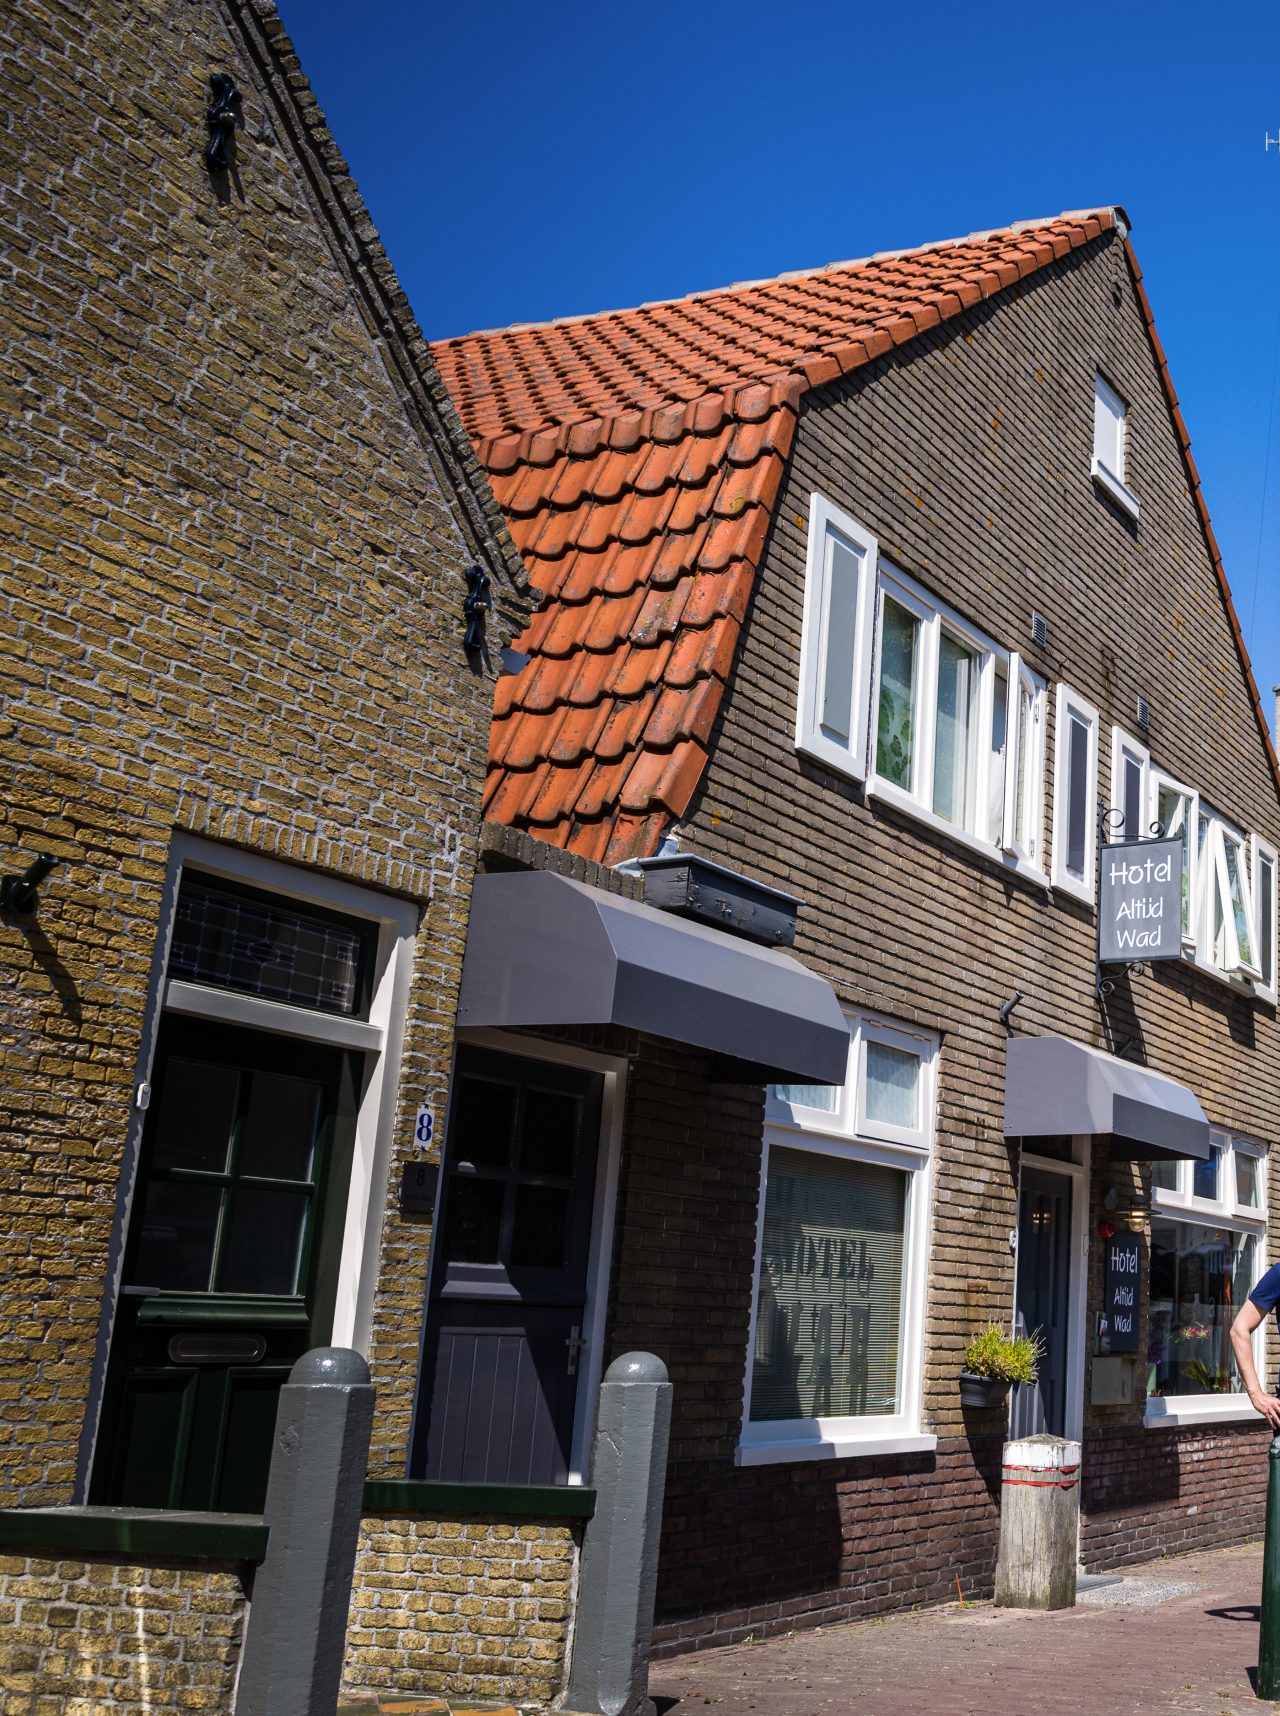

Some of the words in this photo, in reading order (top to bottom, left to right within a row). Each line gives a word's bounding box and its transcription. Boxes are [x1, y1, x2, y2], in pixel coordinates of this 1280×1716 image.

[1109, 855, 1171, 886] Hotel
[1116, 897, 1163, 921] Altijd
[1117, 925, 1161, 949] Wad
[416, 1113, 432, 1142] 8
[416, 1169, 426, 1187] 8
[1111, 1246, 1138, 1274] Hotel
[1113, 1286, 1134, 1306] Altijd
[1114, 1313, 1132, 1333] Wad
